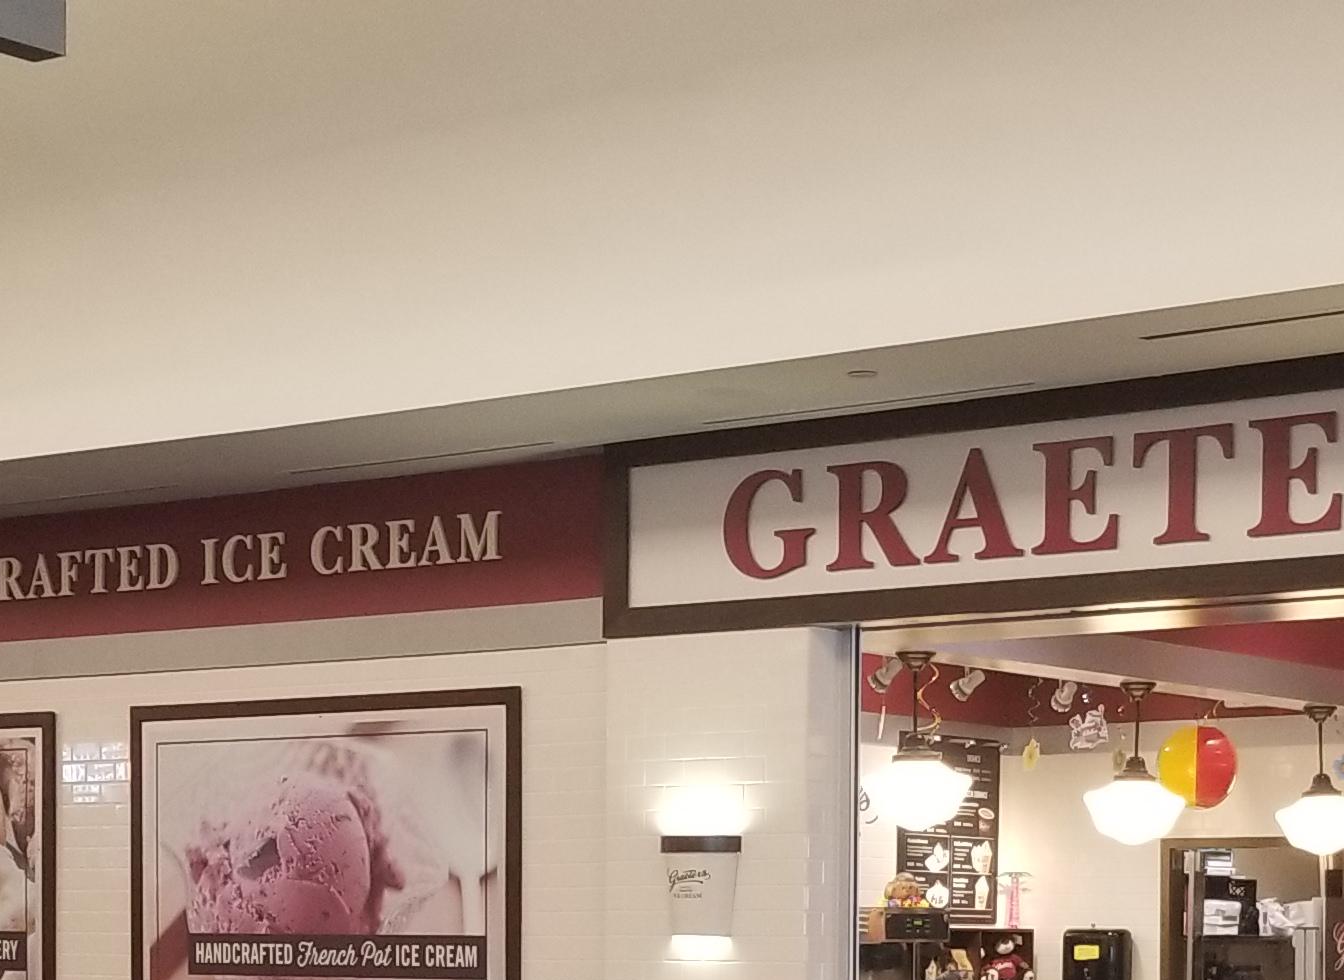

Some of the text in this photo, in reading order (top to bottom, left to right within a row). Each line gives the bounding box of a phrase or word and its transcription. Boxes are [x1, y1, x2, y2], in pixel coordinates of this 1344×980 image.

[200, 531, 288, 586] ICE
[309, 510, 504, 576] CREAM
[194, 940, 479, 969] HANDCRAFTED French Pot ICE CREAM
